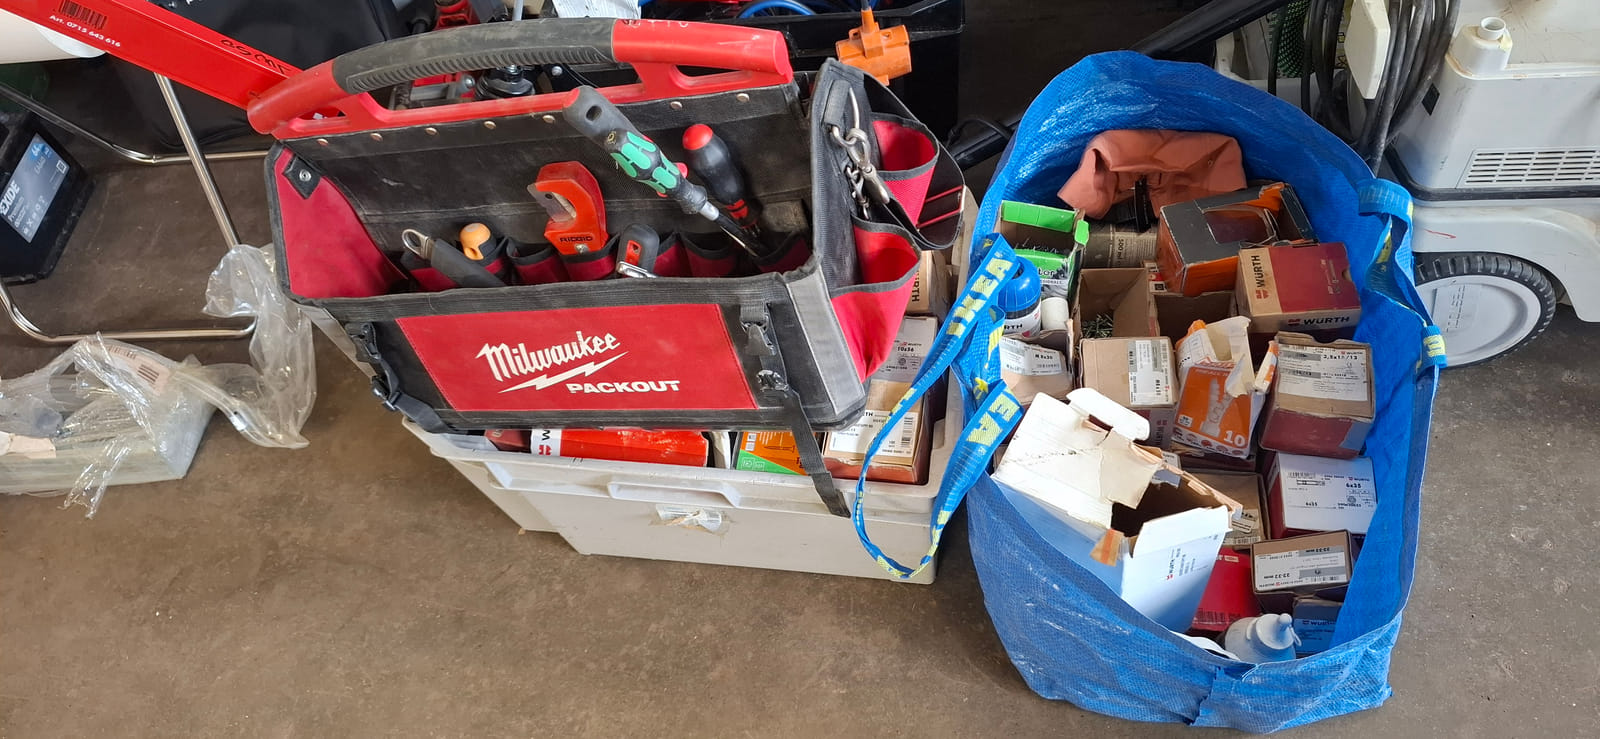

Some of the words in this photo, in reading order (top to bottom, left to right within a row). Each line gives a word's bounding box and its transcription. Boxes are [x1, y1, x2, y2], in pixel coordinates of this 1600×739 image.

[49, 15, 64, 24] Art.
[66, 21, 87, 33] 0715
[88, 31, 104, 40] 643
[105, 37, 120, 47] 616
[1, 180, 20, 215] EXIDE
[946, 257, 1014, 338] IKEA
[475, 331, 620, 382] Milwaukee
[566, 380, 680, 394] PACKOUT
[1223, 430, 1246, 447] 10
